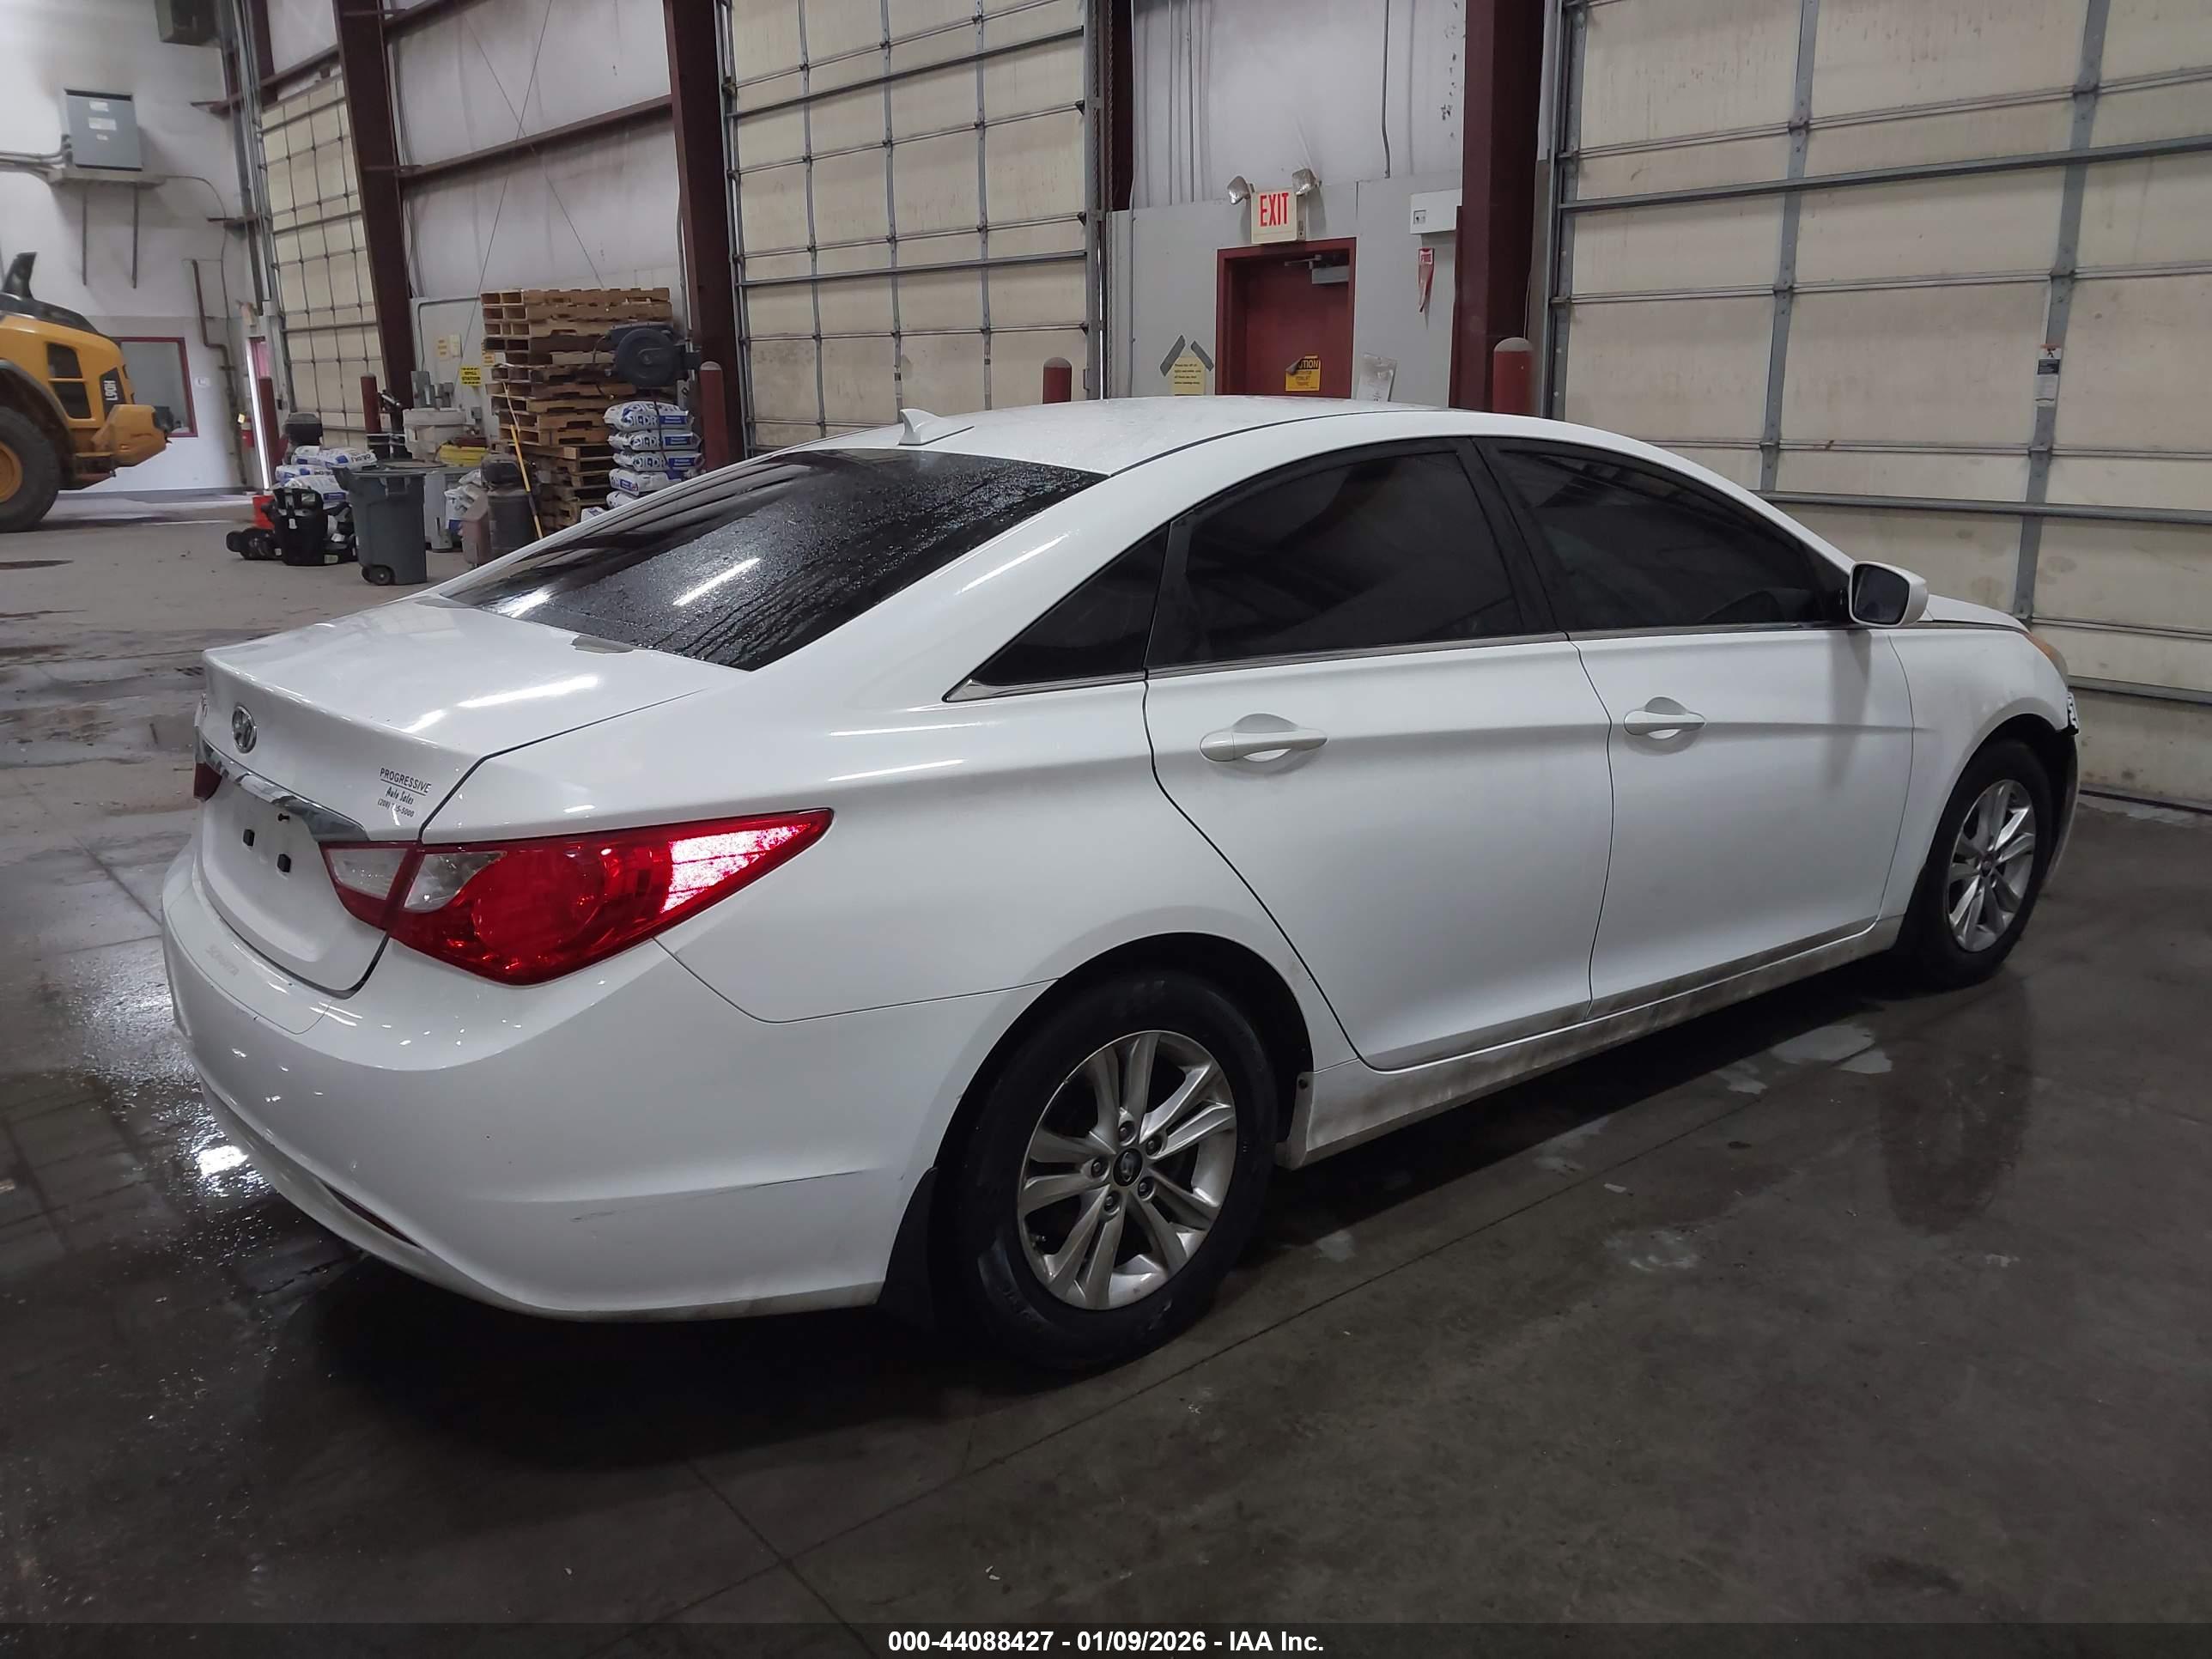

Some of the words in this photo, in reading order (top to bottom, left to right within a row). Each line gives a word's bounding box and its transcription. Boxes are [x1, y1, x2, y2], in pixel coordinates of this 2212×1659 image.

[1260, 192, 1289, 227] EXIT
[380, 768, 432, 793] PROGRESSIVE
[386, 786, 399, 799] Auto
[399, 790, 414, 805] Sales
